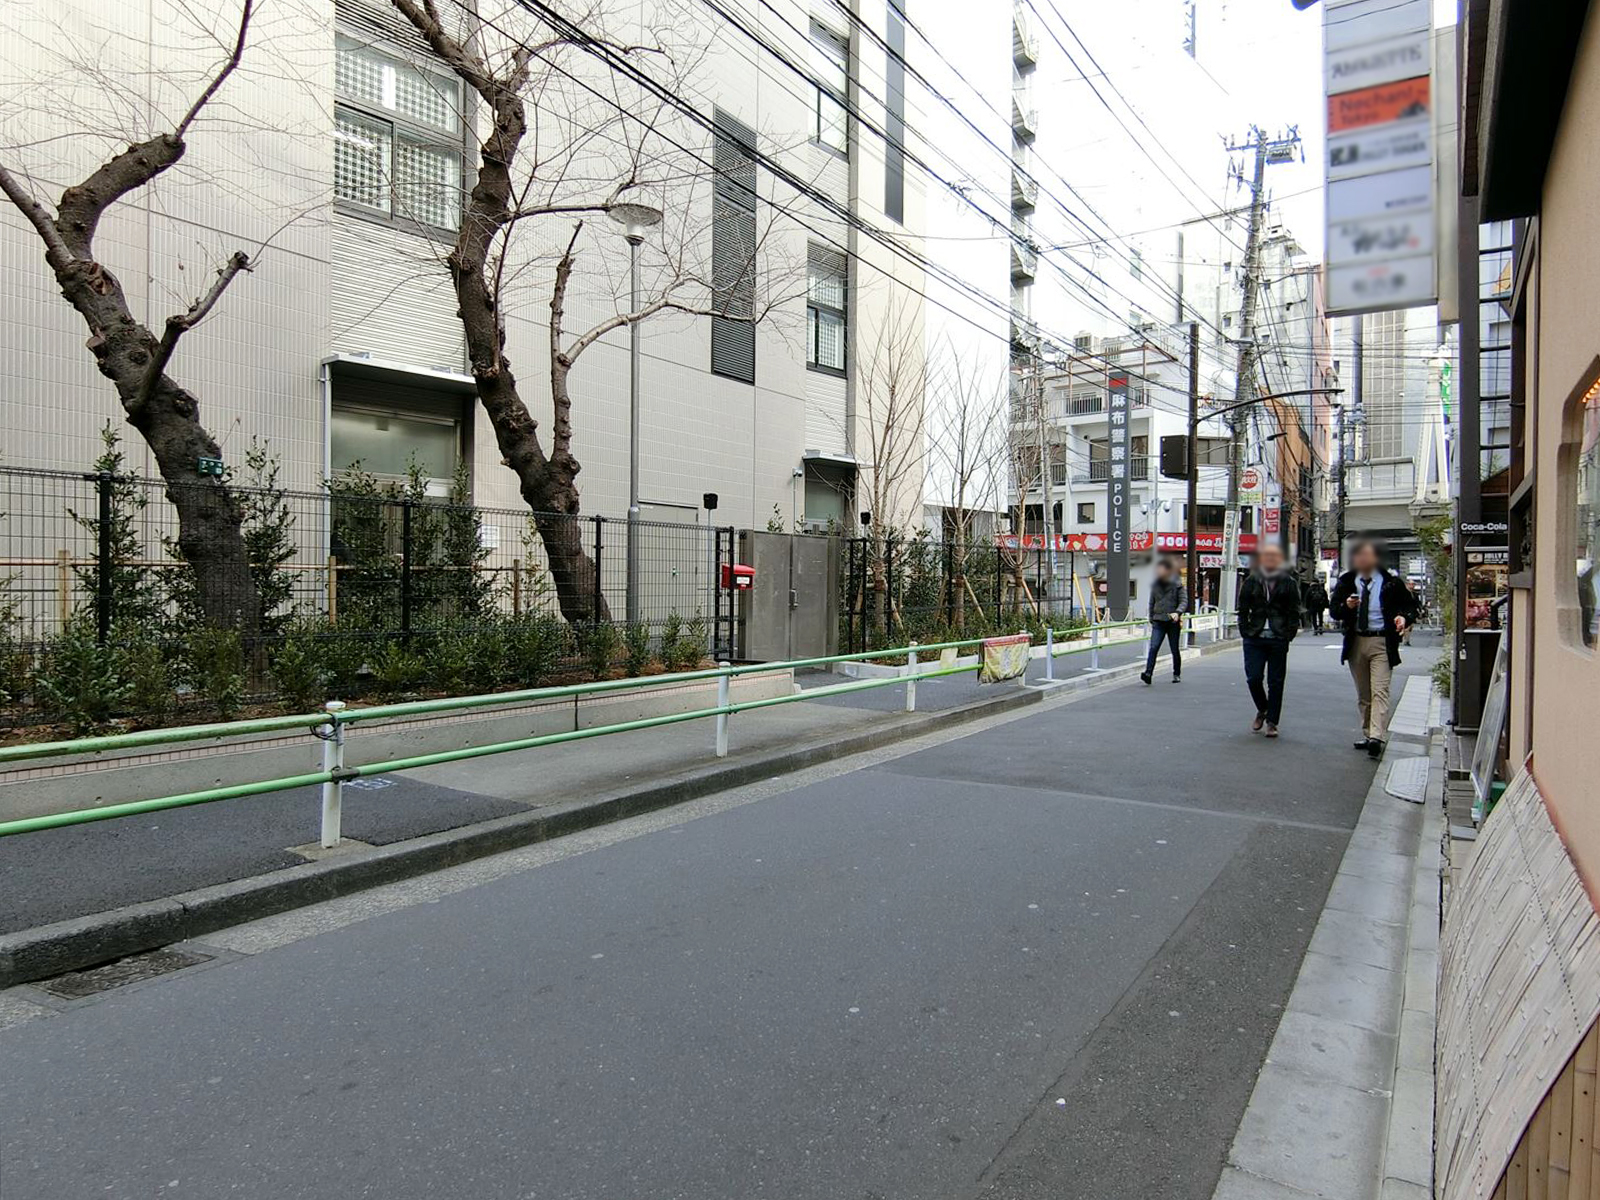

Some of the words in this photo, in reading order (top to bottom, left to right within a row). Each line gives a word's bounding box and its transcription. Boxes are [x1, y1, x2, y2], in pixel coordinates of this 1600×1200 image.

[1111, 393, 1125, 478] 麻布警察署
[1112, 483, 1123, 553] POLICE
[1460, 522, 1508, 531] Coca-Cola
